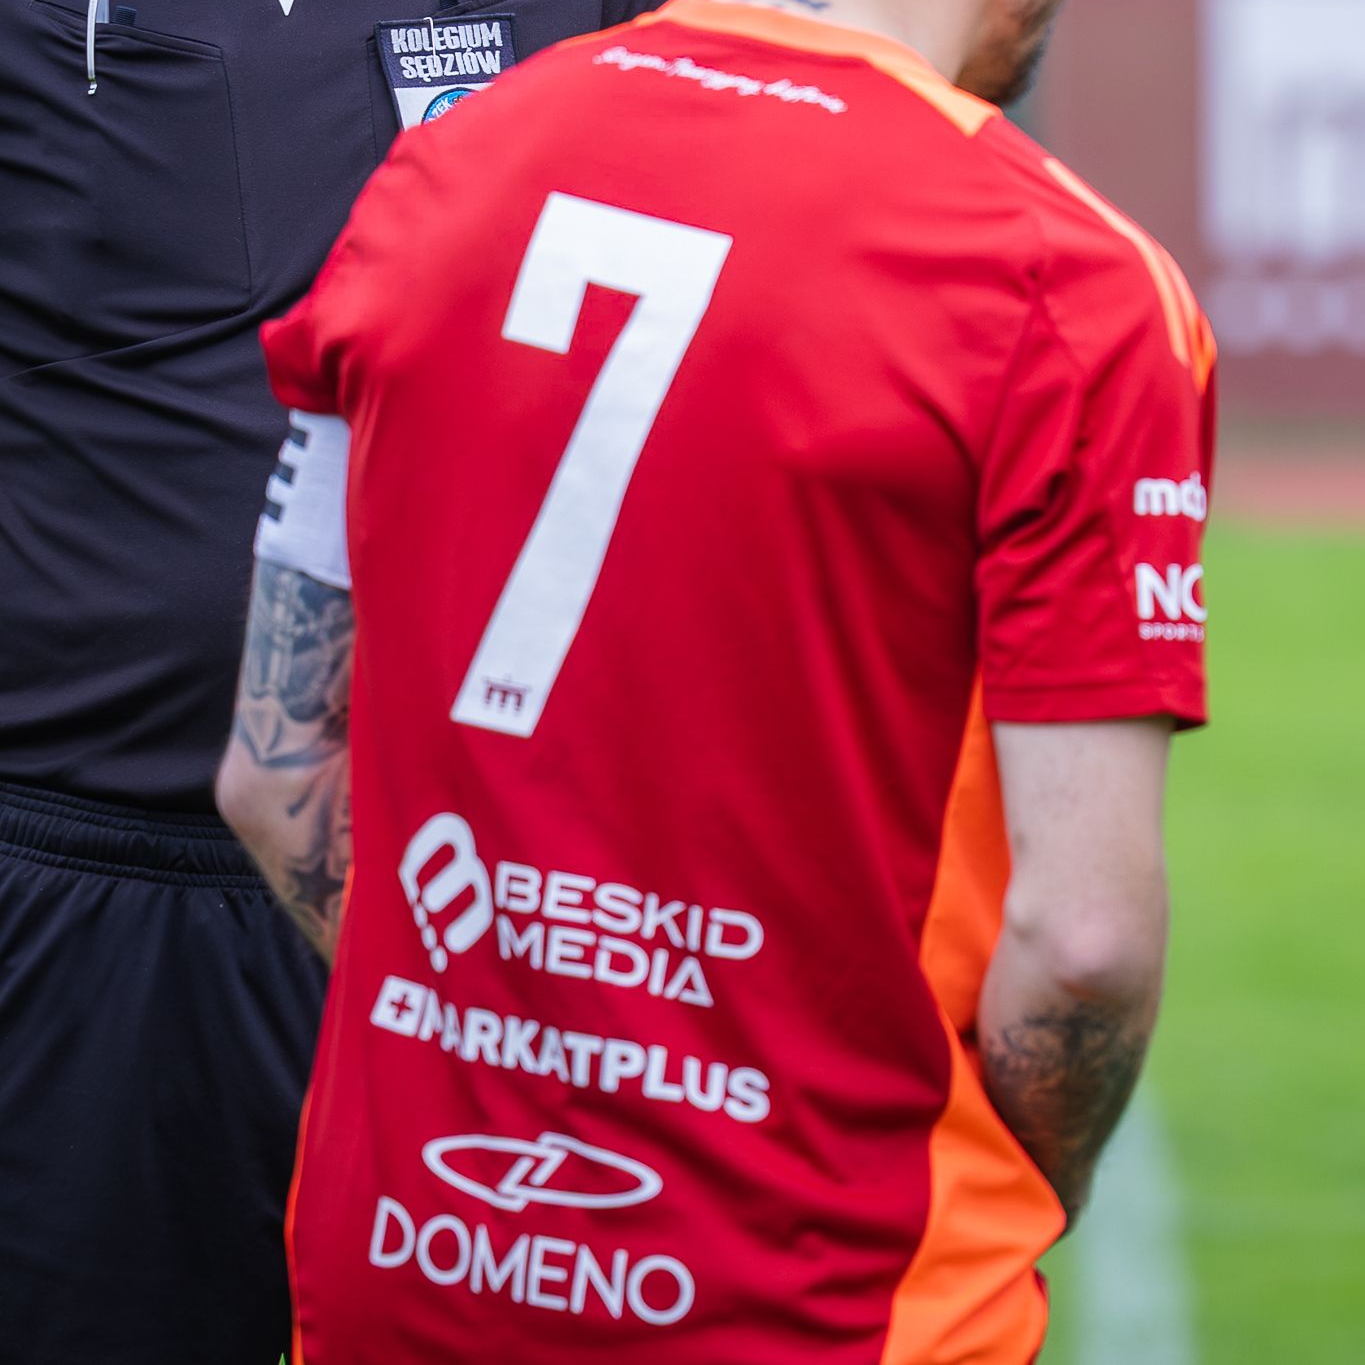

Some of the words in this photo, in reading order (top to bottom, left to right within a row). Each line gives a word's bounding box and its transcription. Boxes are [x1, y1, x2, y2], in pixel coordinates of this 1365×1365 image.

[390, 21, 503, 54] KOLEGIUM
[399, 47, 501, 83] SĘDZIÓW
[449, 190, 733, 739] 7
[495, 859, 765, 962] BESKID
[496, 914, 715, 1009] MEDIA
[369, 1194, 697, 1326] DOMENO
